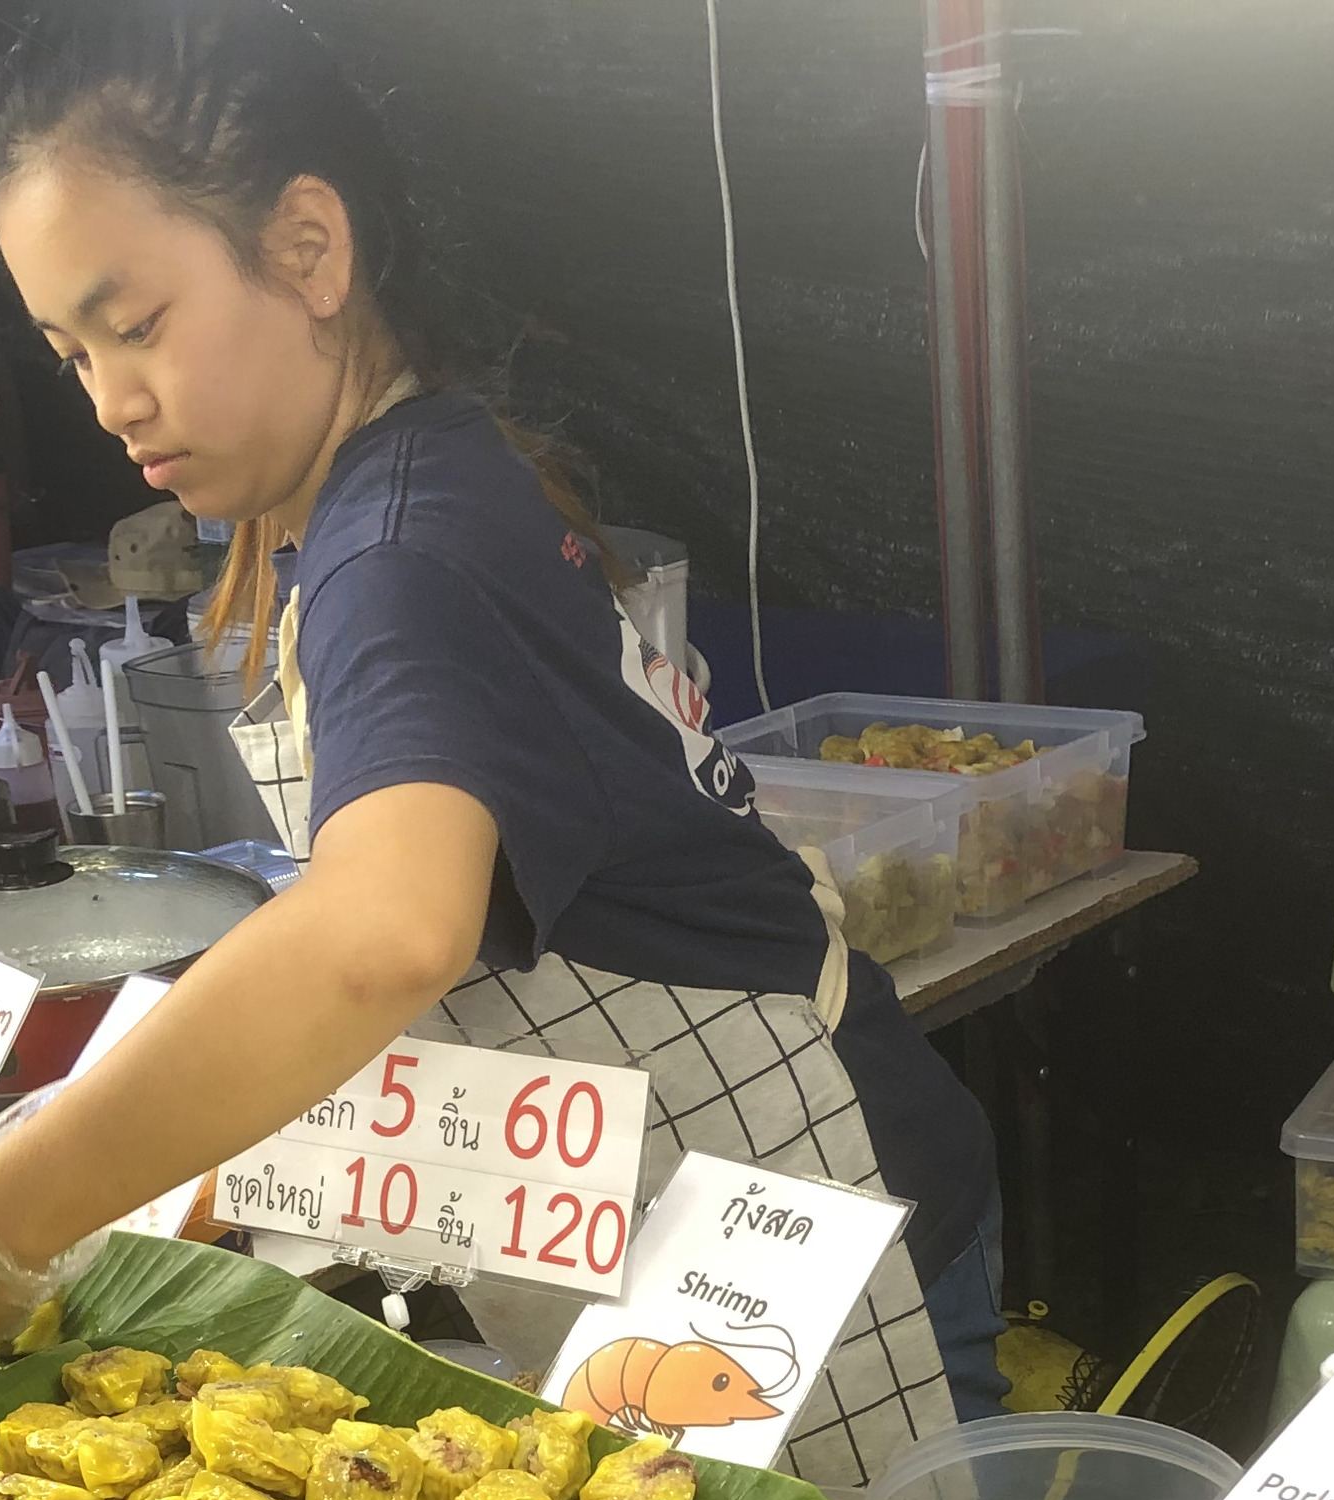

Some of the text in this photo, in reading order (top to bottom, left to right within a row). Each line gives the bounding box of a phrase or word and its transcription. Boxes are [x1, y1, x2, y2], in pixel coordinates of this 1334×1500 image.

[370, 1053, 419, 1138] 5
[438, 1087, 481, 1151] ชิ้น
[505, 1075, 604, 1168] 60
[225, 1156, 626, 1275] ชุดใหญ่ 10 ชิ้น 120
[720, 1182, 814, 1245] กุ้งสด
[677, 1270, 768, 1322] Shrimp
